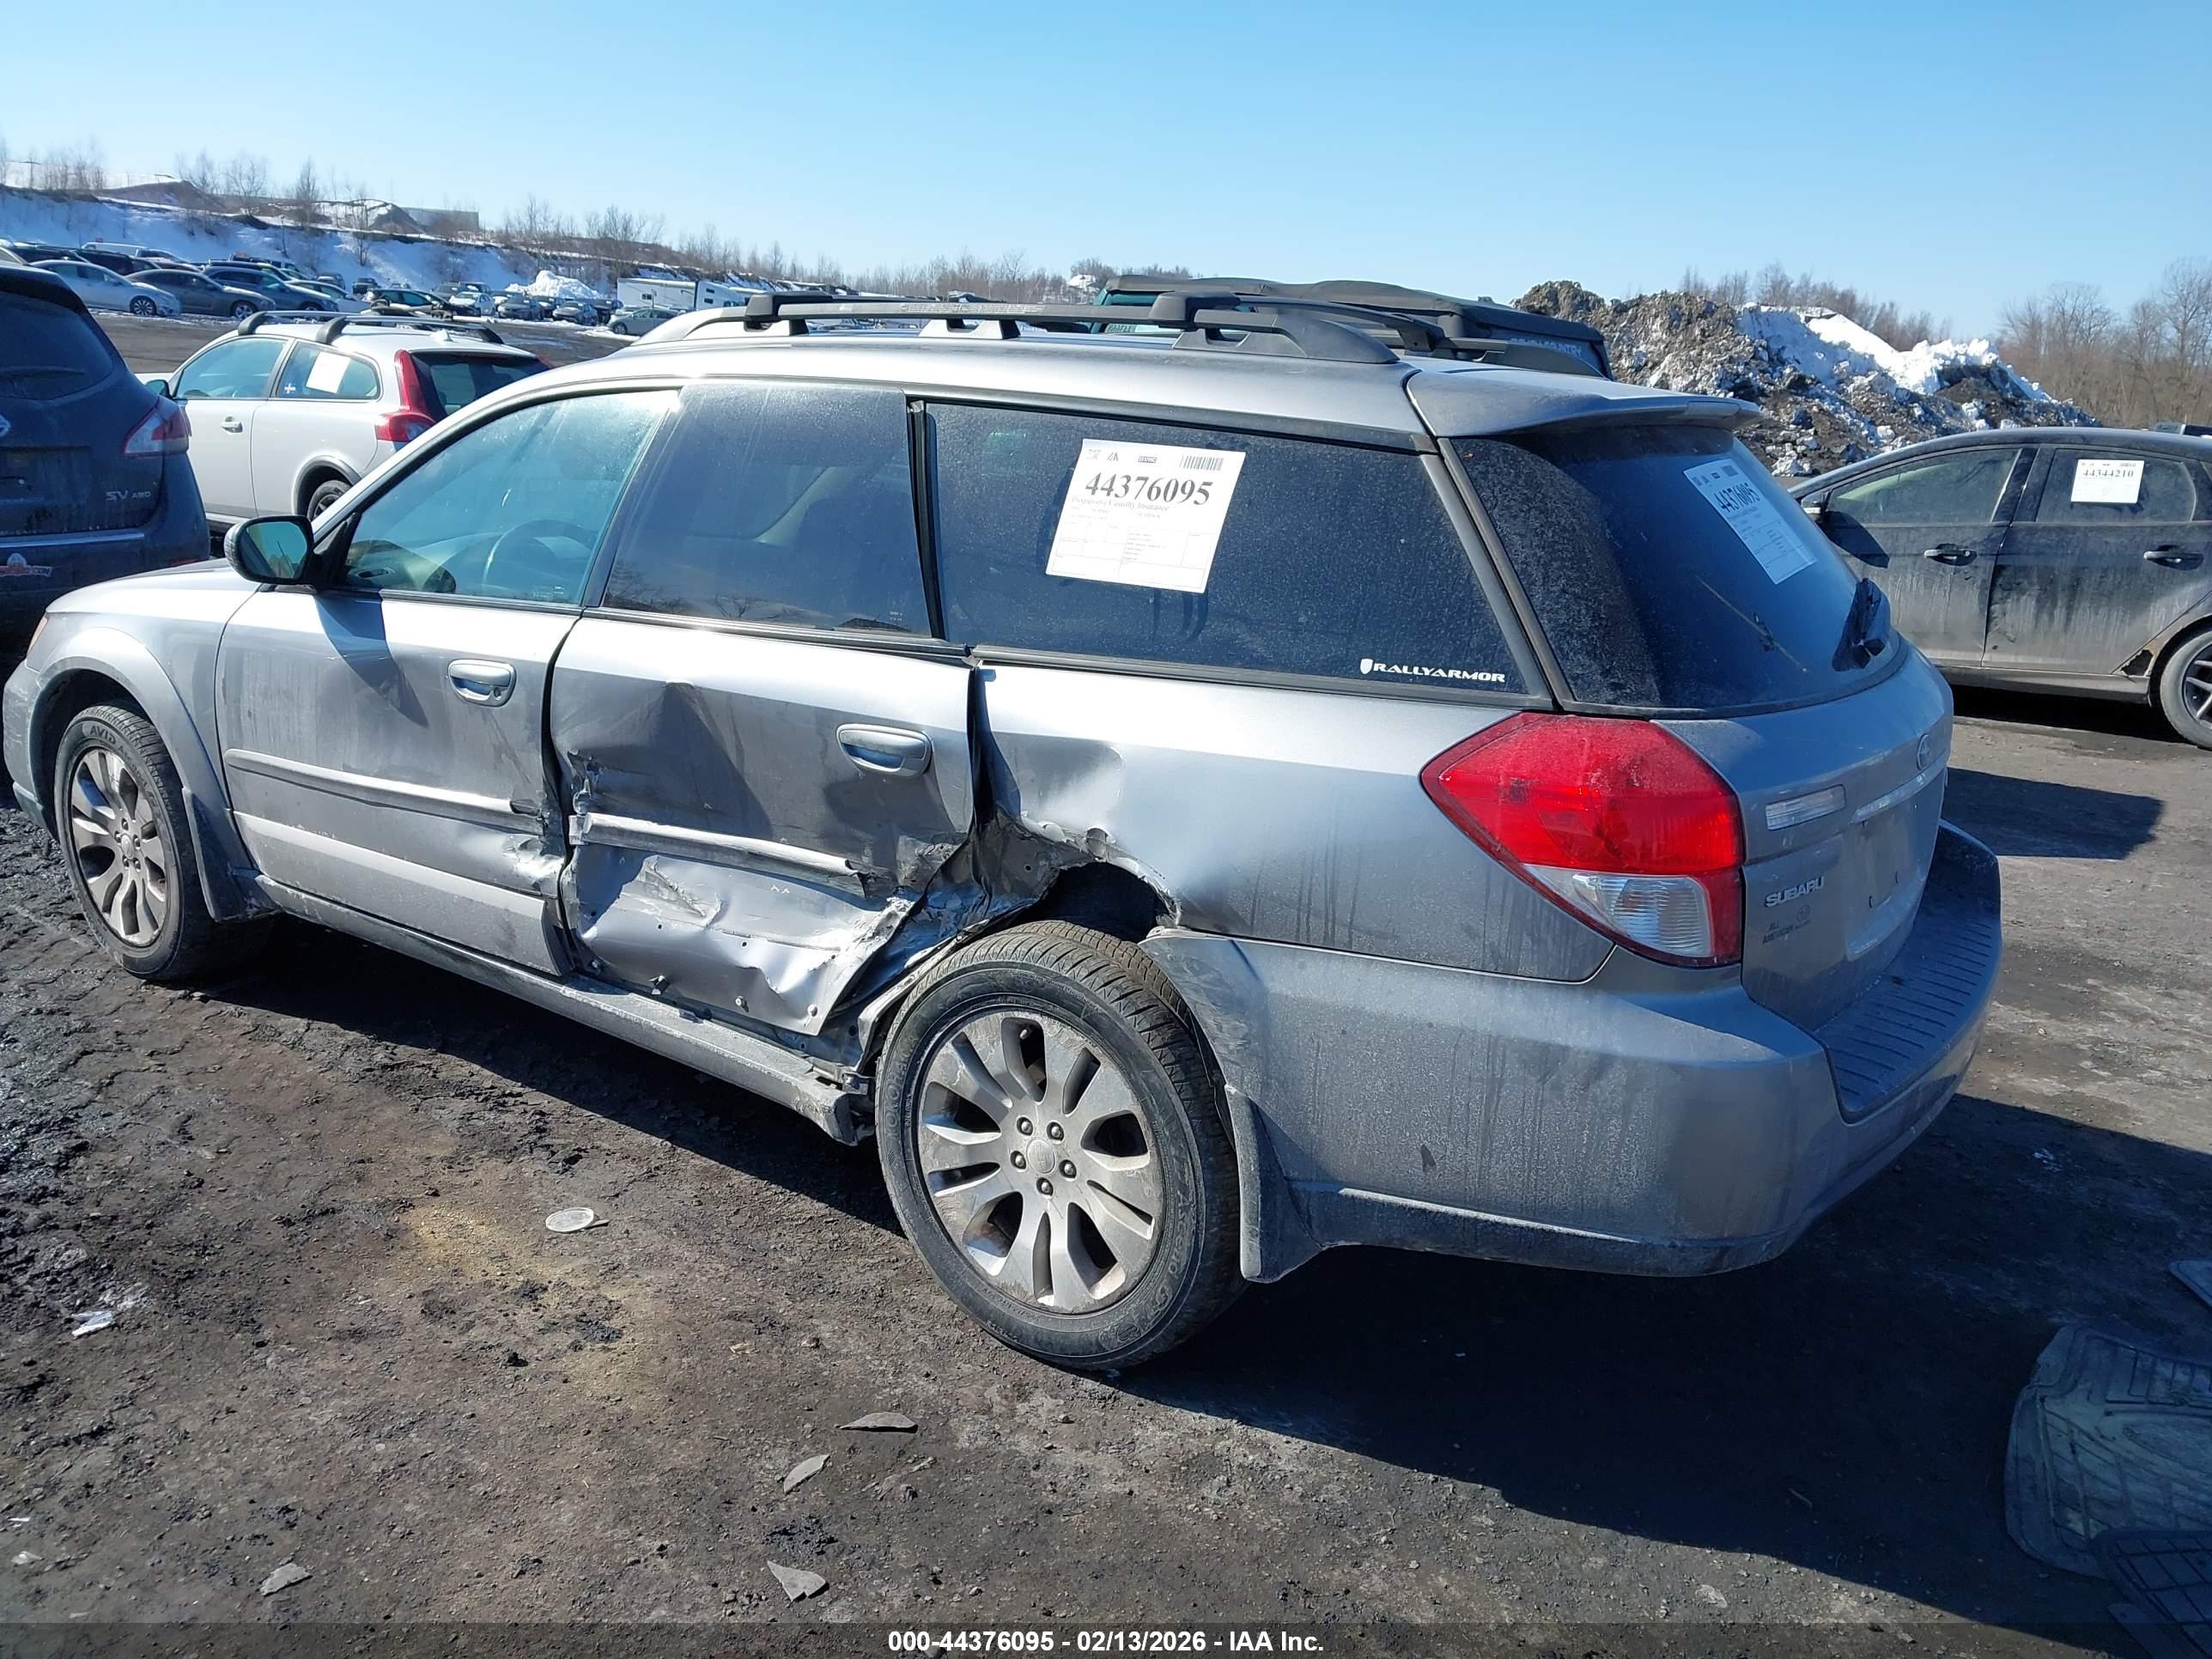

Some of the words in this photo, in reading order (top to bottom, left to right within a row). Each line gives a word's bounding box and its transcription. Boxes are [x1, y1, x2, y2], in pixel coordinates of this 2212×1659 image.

[2082, 469, 2134, 477] 44344210
[105, 489, 129, 501] SV
[1085, 472, 1214, 505] 44376095
[1713, 482, 1760, 513] 44376095
[89, 725, 118, 744] AVID
[1764, 875, 1825, 908] SUBARU
